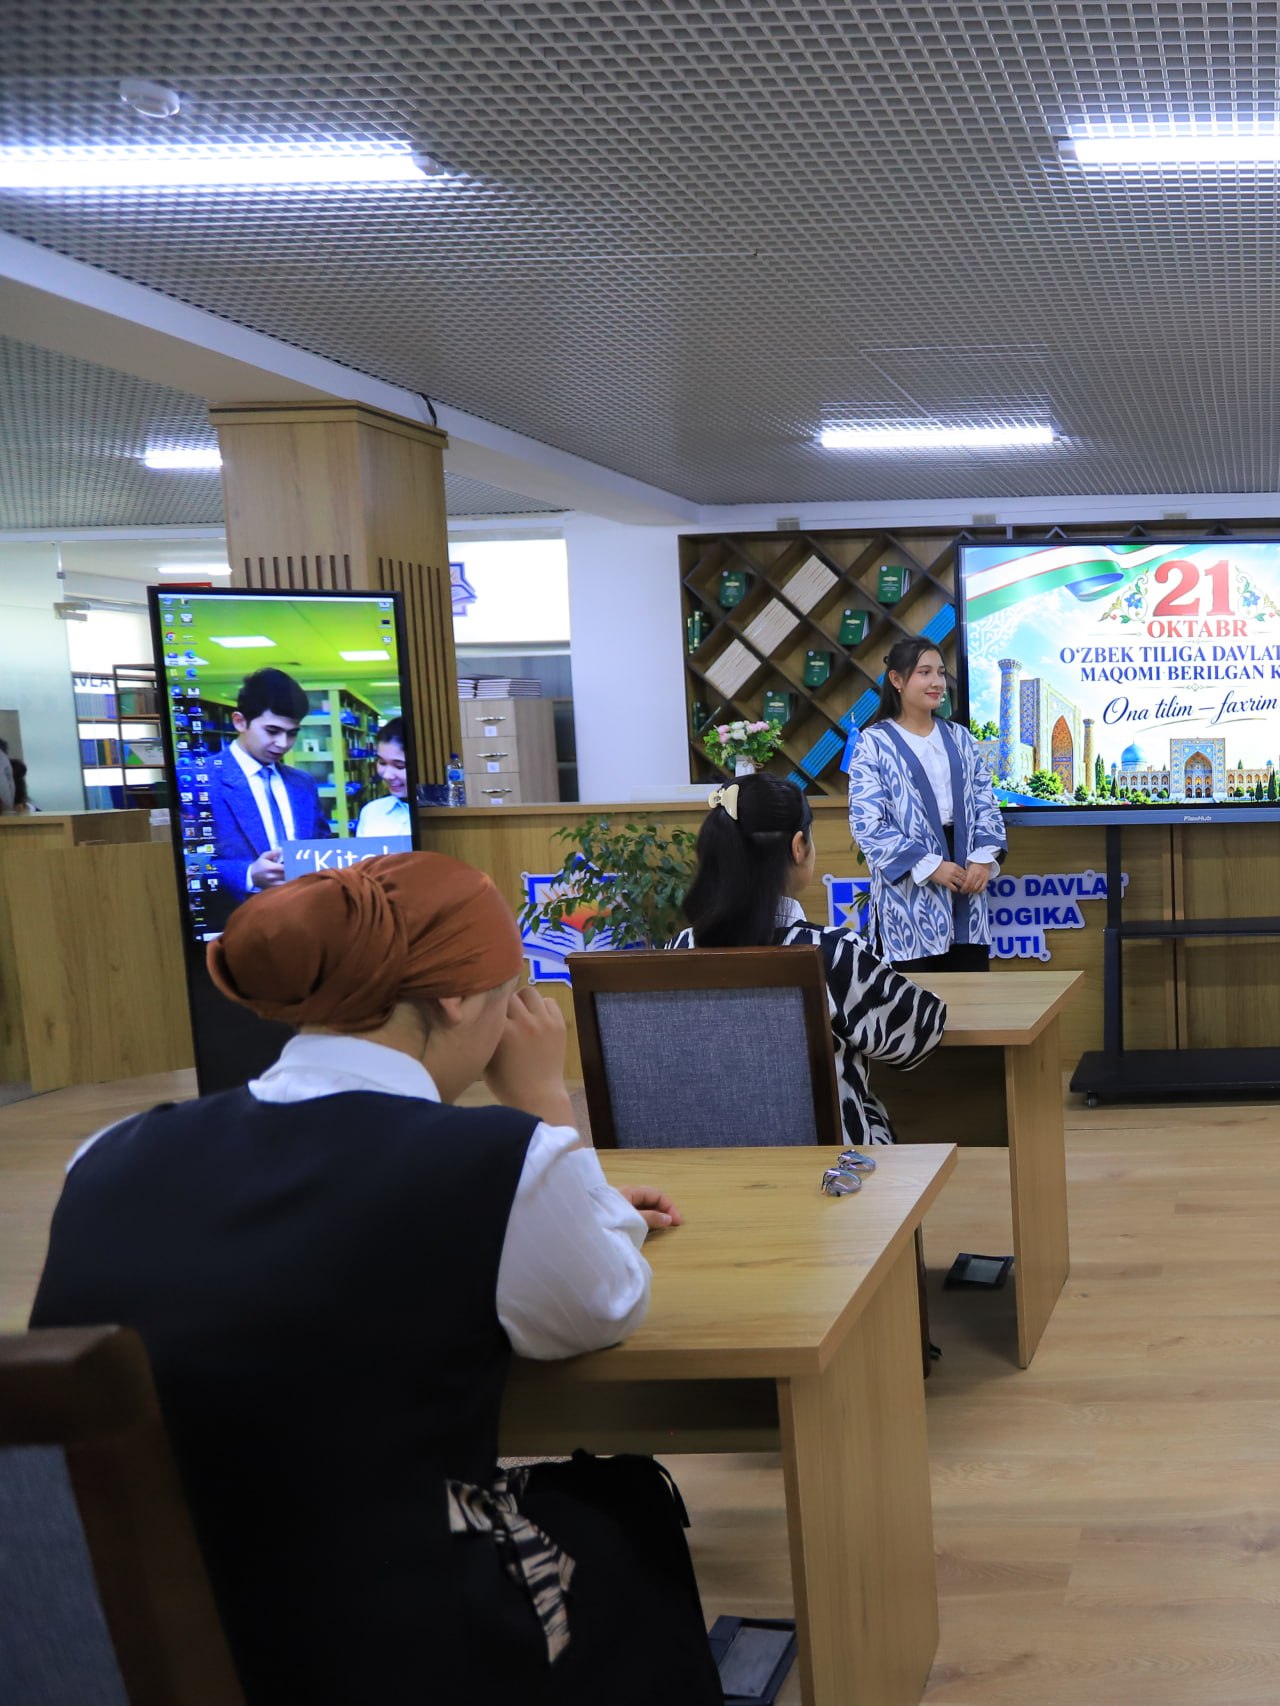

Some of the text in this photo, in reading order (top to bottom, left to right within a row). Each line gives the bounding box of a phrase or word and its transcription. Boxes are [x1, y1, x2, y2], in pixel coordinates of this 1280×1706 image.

[1153, 559, 1235, 617] 21
[1147, 619, 1249, 639] OKTABR
[1139, 645, 1206, 663] TILIGA
[1080, 665, 1161, 684] MAQOMI
[1167, 664, 1264, 680] BERILGAN
[1102, 696, 1150, 725] Ona
[1155, 695, 1193, 719] tilim
[1024, 877, 1124, 897] DAVLA
